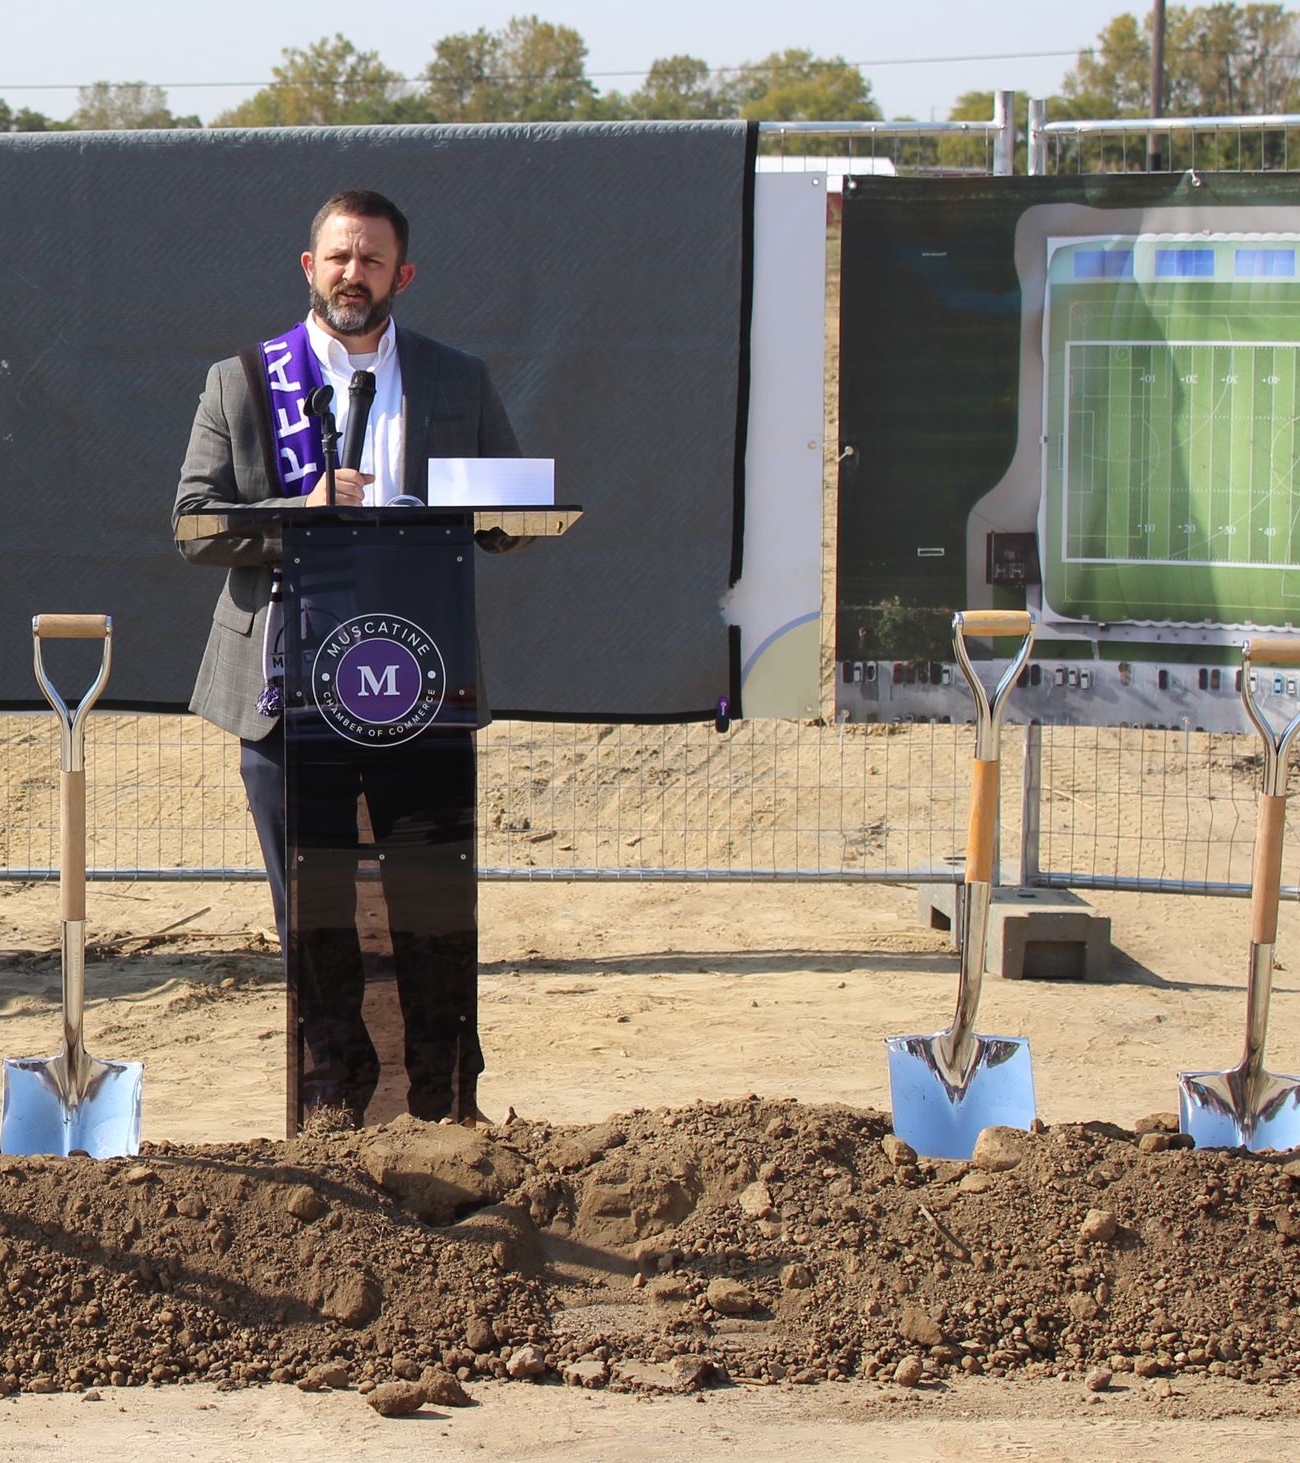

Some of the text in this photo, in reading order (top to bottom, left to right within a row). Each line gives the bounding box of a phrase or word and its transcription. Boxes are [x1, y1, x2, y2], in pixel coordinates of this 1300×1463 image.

[1144, 524, 1277, 537] 10 20 30 40
[327, 621, 431, 659] MUSCATINE
[357, 665, 401, 697] M
[323, 689, 436, 738] CHAMBER OF COMMERCE
